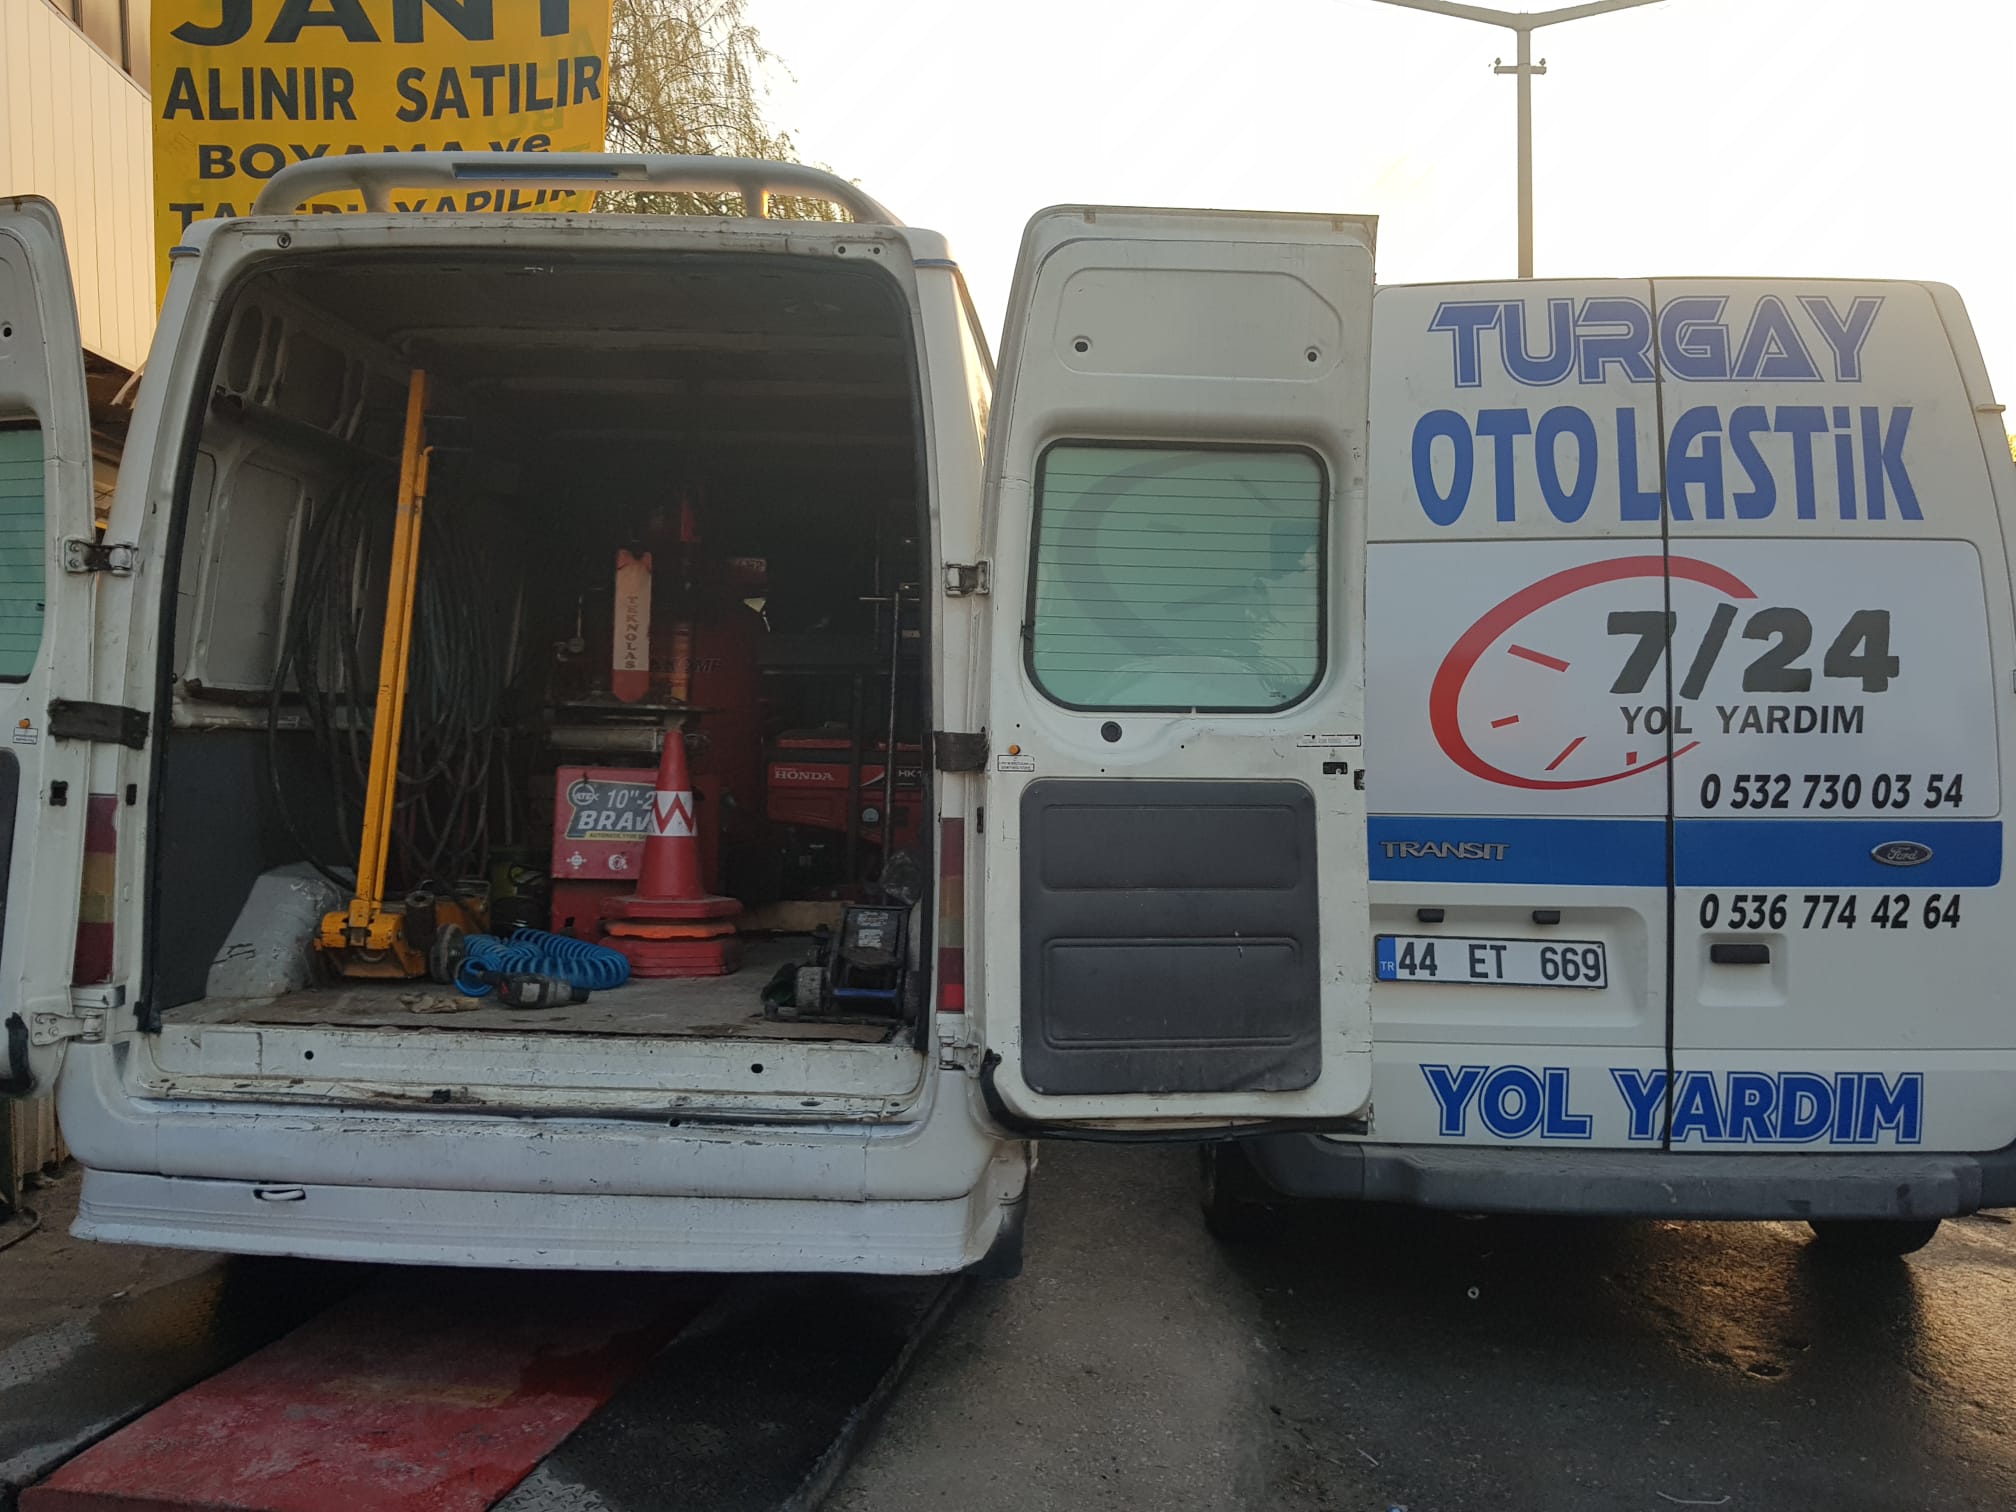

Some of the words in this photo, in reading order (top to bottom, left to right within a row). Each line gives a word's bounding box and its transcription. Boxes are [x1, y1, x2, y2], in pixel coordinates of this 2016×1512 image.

[162, 66, 357, 121] ALINIR
[395, 55, 602, 123] SATILIR
[1427, 294, 1886, 388] TURGAY
[1411, 405, 1599, 526] OTO
[624, 595, 639, 669] TEKNOLAS
[1607, 602, 1900, 700] 7/24
[1619, 704, 1693, 735] YOL
[1715, 704, 1865, 735] YARDIM
[775, 771, 835, 781] HONDA
[1700, 773, 1721, 809] 0
[1730, 773, 1792, 810] 532
[1802, 773, 1862, 810] 730
[1871, 773, 1912, 809] 03
[1923, 773, 1964, 809] 54
[577, 810, 653, 831] BRAV
[1380, 841, 1510, 862] TRANSIT
[1699, 893, 1720, 929] 0
[1728, 893, 1788, 930] 536
[1802, 894, 1857, 929] 774
[1871, 894, 1910, 929] 42
[1923, 893, 1961, 929] 64
[1380, 961, 1395, 972] TR
[1398, 941, 1438, 978] 44
[1468, 943, 1507, 979] ET
[1540, 946, 1601, 983] 669
[1419, 1063, 1593, 1140] YOL
[1608, 1068, 1924, 1145] YARDIM
